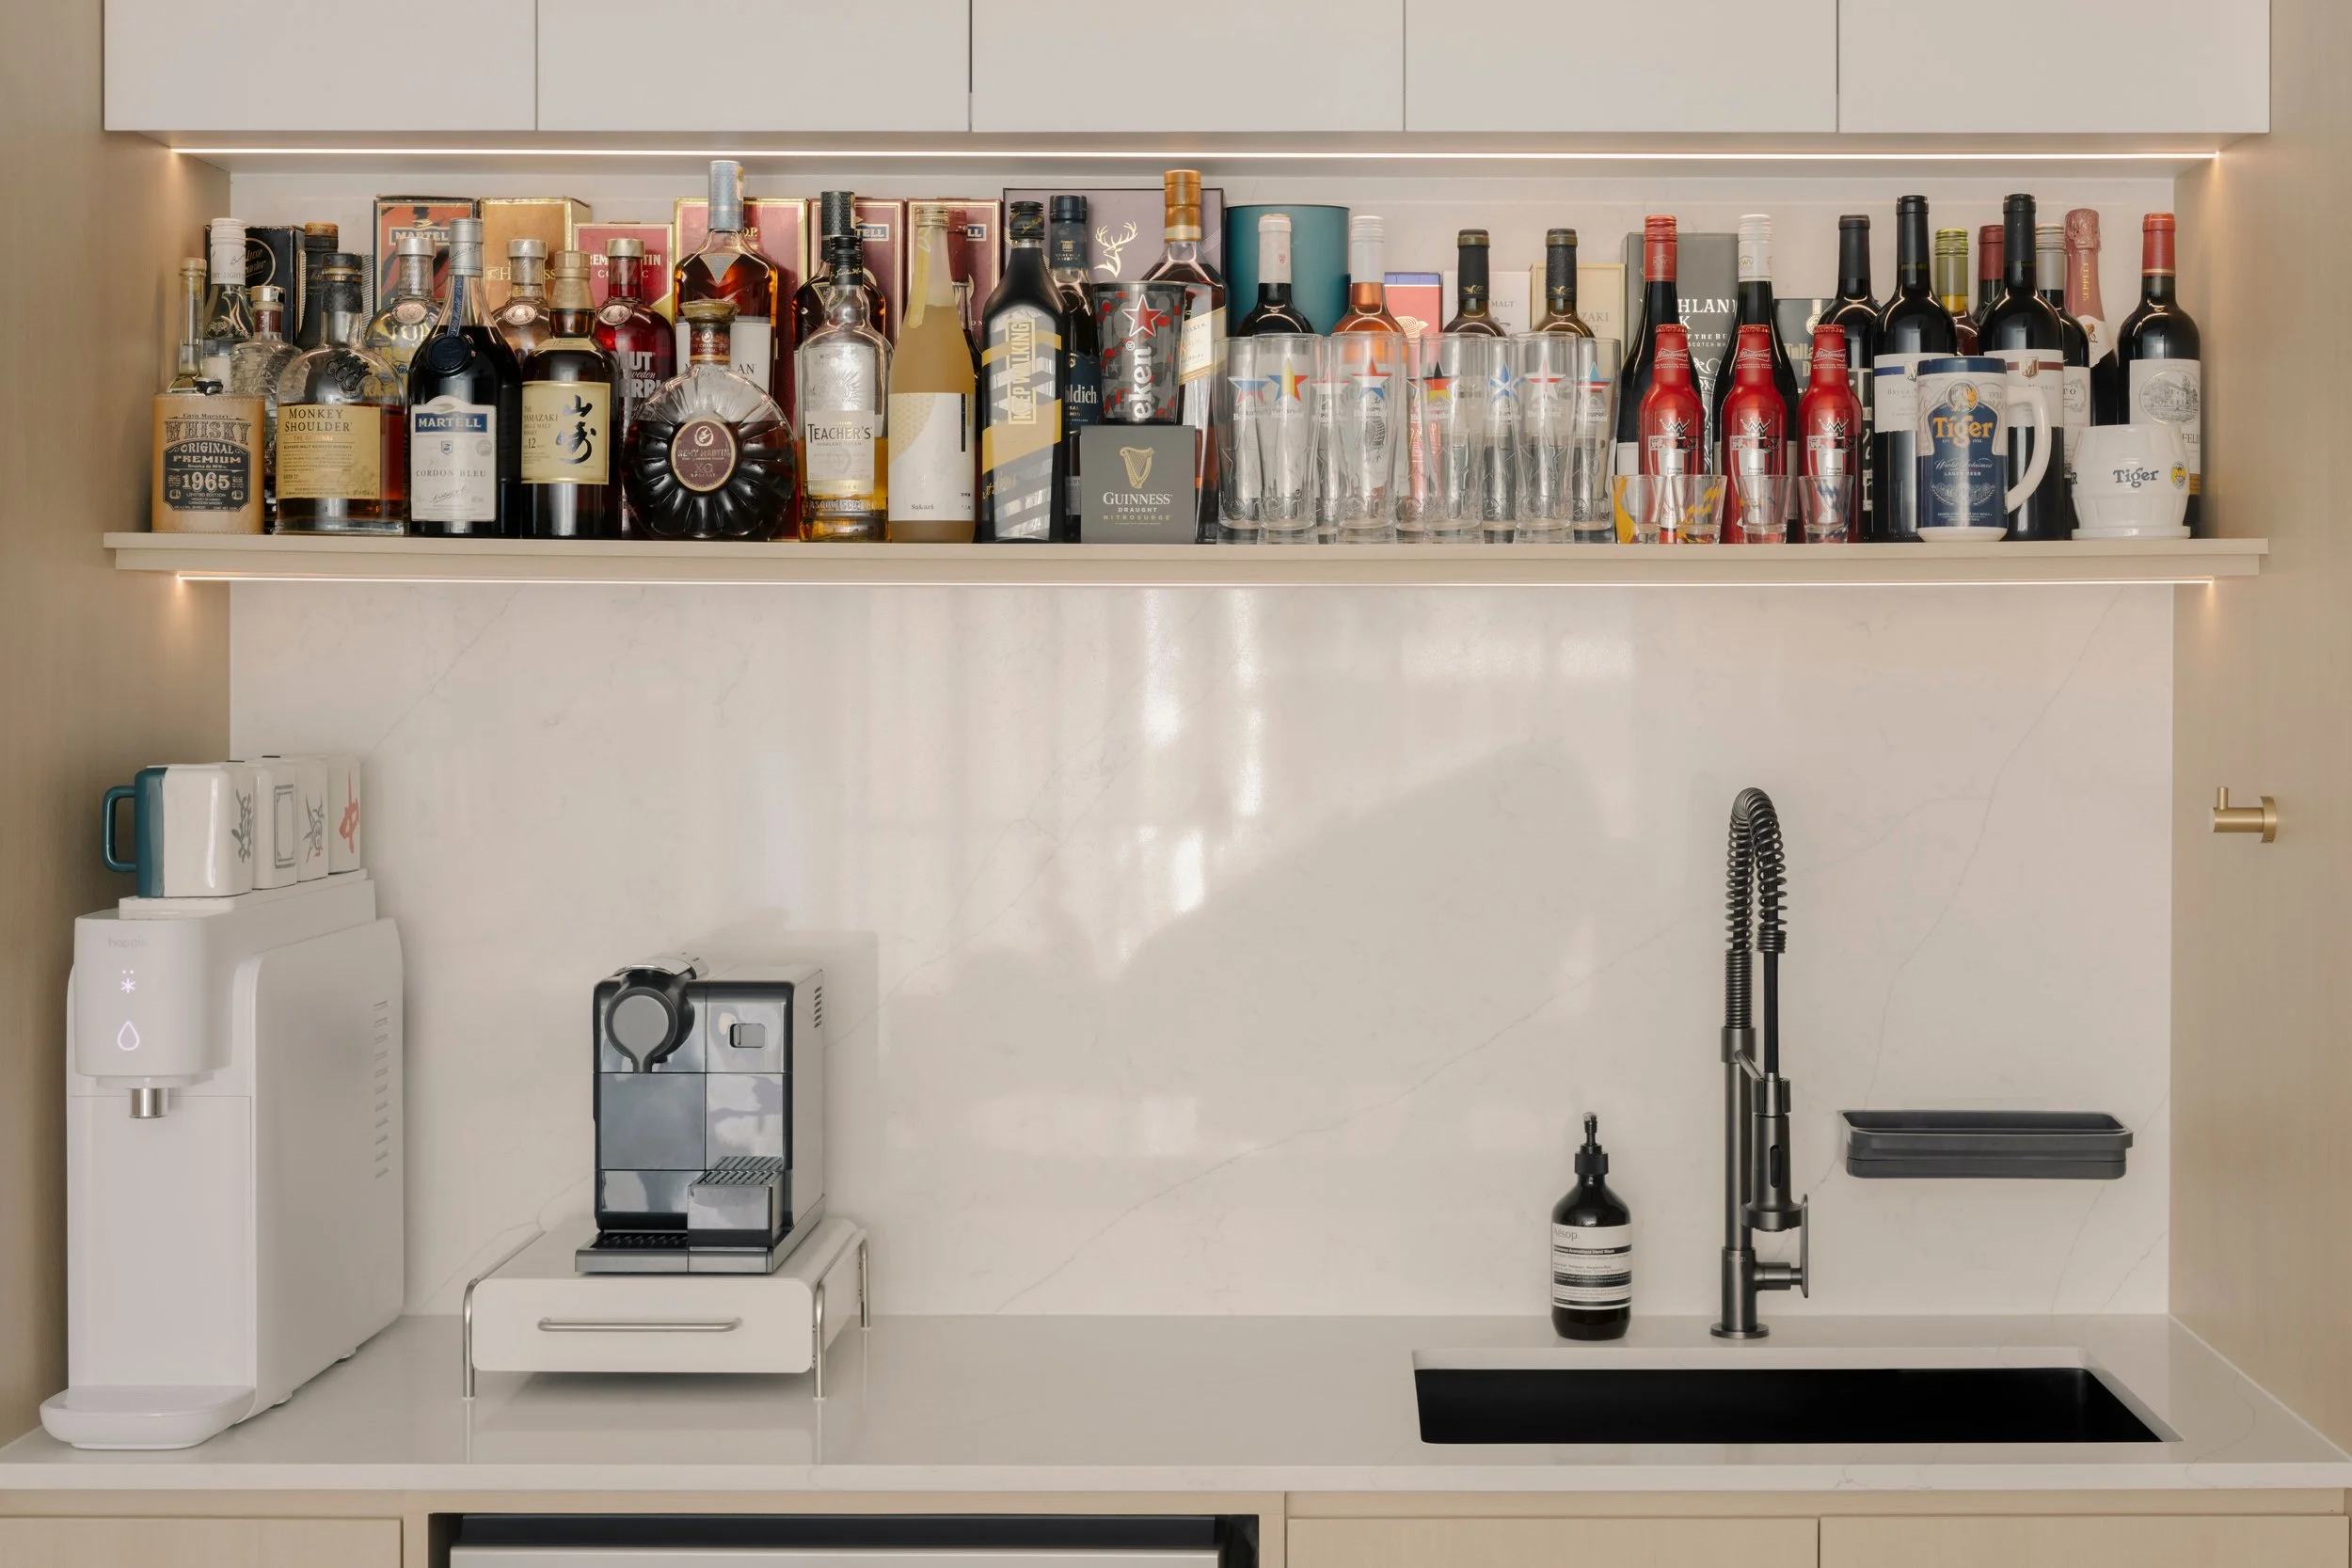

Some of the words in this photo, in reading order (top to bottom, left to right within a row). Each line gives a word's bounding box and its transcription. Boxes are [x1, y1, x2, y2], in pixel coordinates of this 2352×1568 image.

[395, 231, 450, 242] MARTEL
[855, 229, 884, 237] TELL
[644, 254, 661, 265] TIN
[1677, 298, 1738, 313] HLAN
[1581, 312, 1610, 323] ZAKI
[1010, 322, 1031, 384] WALKING
[1128, 345, 1152, 420] eken
[289, 408, 343, 420] MONKEY
[284, 421, 351, 433] SHOULDER
[418, 418, 482, 428] MARTELL
[165, 420, 251, 446] WHISKY
[807, 423, 871, 443] TEACHER'S
[1933, 415, 1994, 449] Tiger
[180, 441, 234, 455] ORIGINAL
[528, 438, 536, 449] 12
[172, 455, 242, 464] PREMIUM
[182, 471, 231, 493] 1965
[2112, 467, 2160, 488] Tiger
[1103, 491, 1170, 505] GUINNESS
